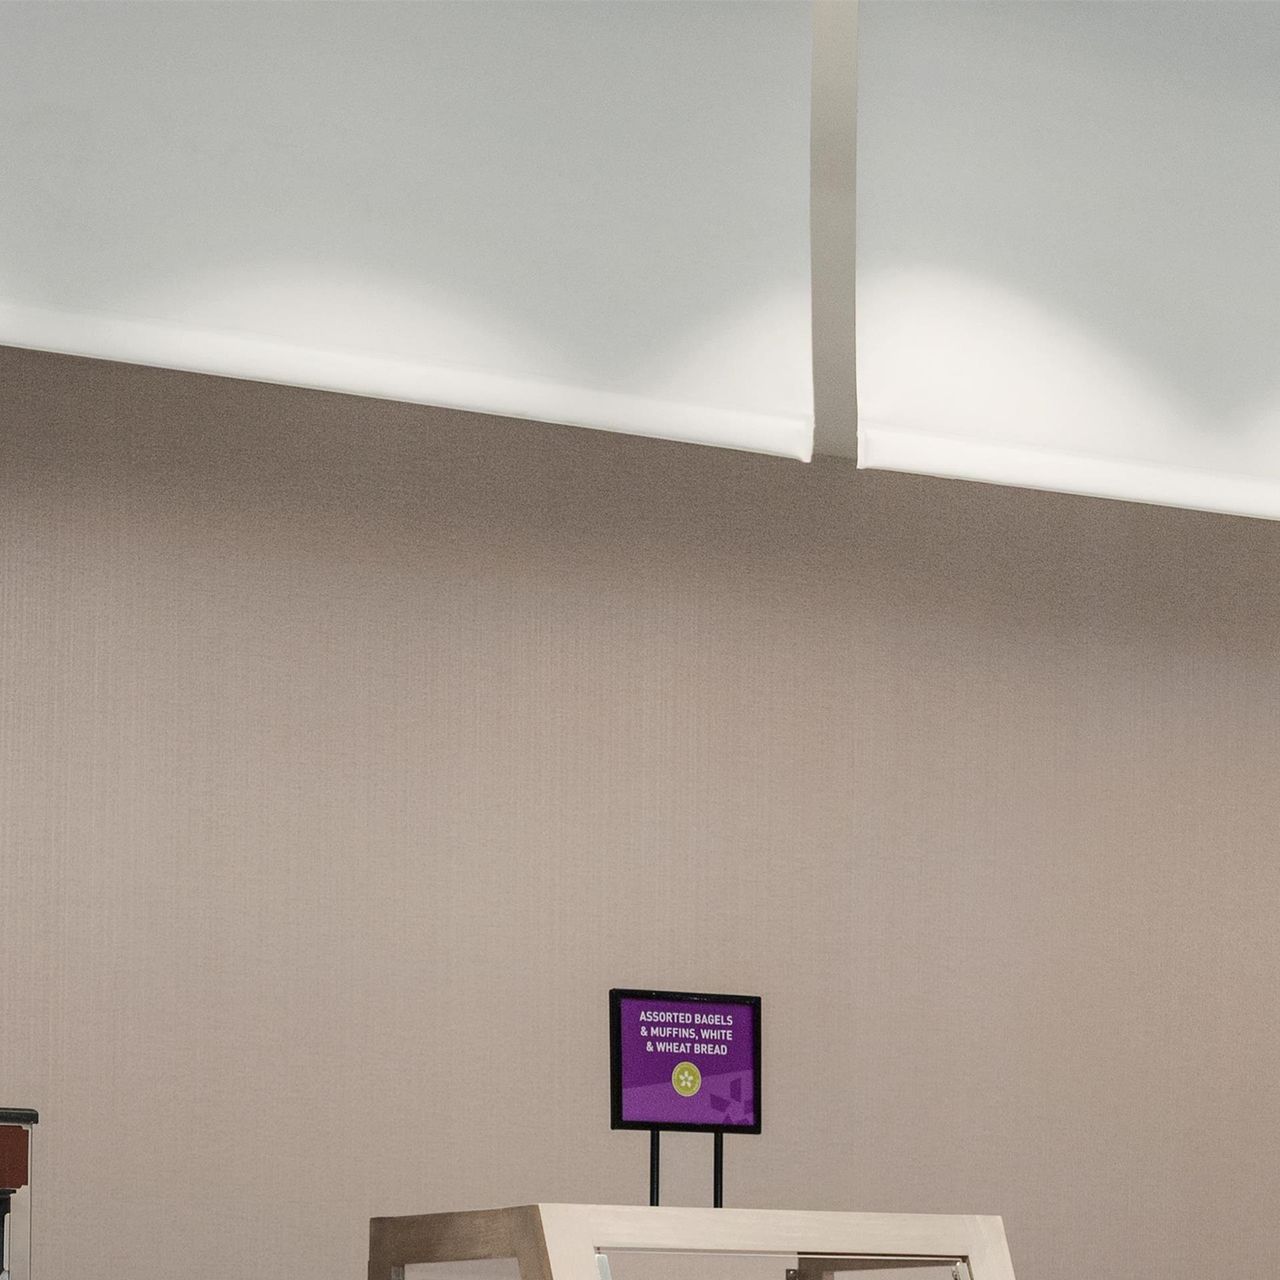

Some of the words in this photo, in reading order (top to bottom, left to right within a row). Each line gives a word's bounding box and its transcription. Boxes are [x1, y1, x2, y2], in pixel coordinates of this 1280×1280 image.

[640, 1011, 692, 1024] ASSORTED
[694, 1013, 733, 1025] BAGELS
[640, 1026, 648, 1036] &
[650, 1026, 699, 1040] MUFFINS,
[700, 1029, 733, 1040] WHITE
[646, 1041, 653, 1052] &
[656, 1041, 692, 1053] WHEAT
[694, 1043, 727, 1055] BREAD
